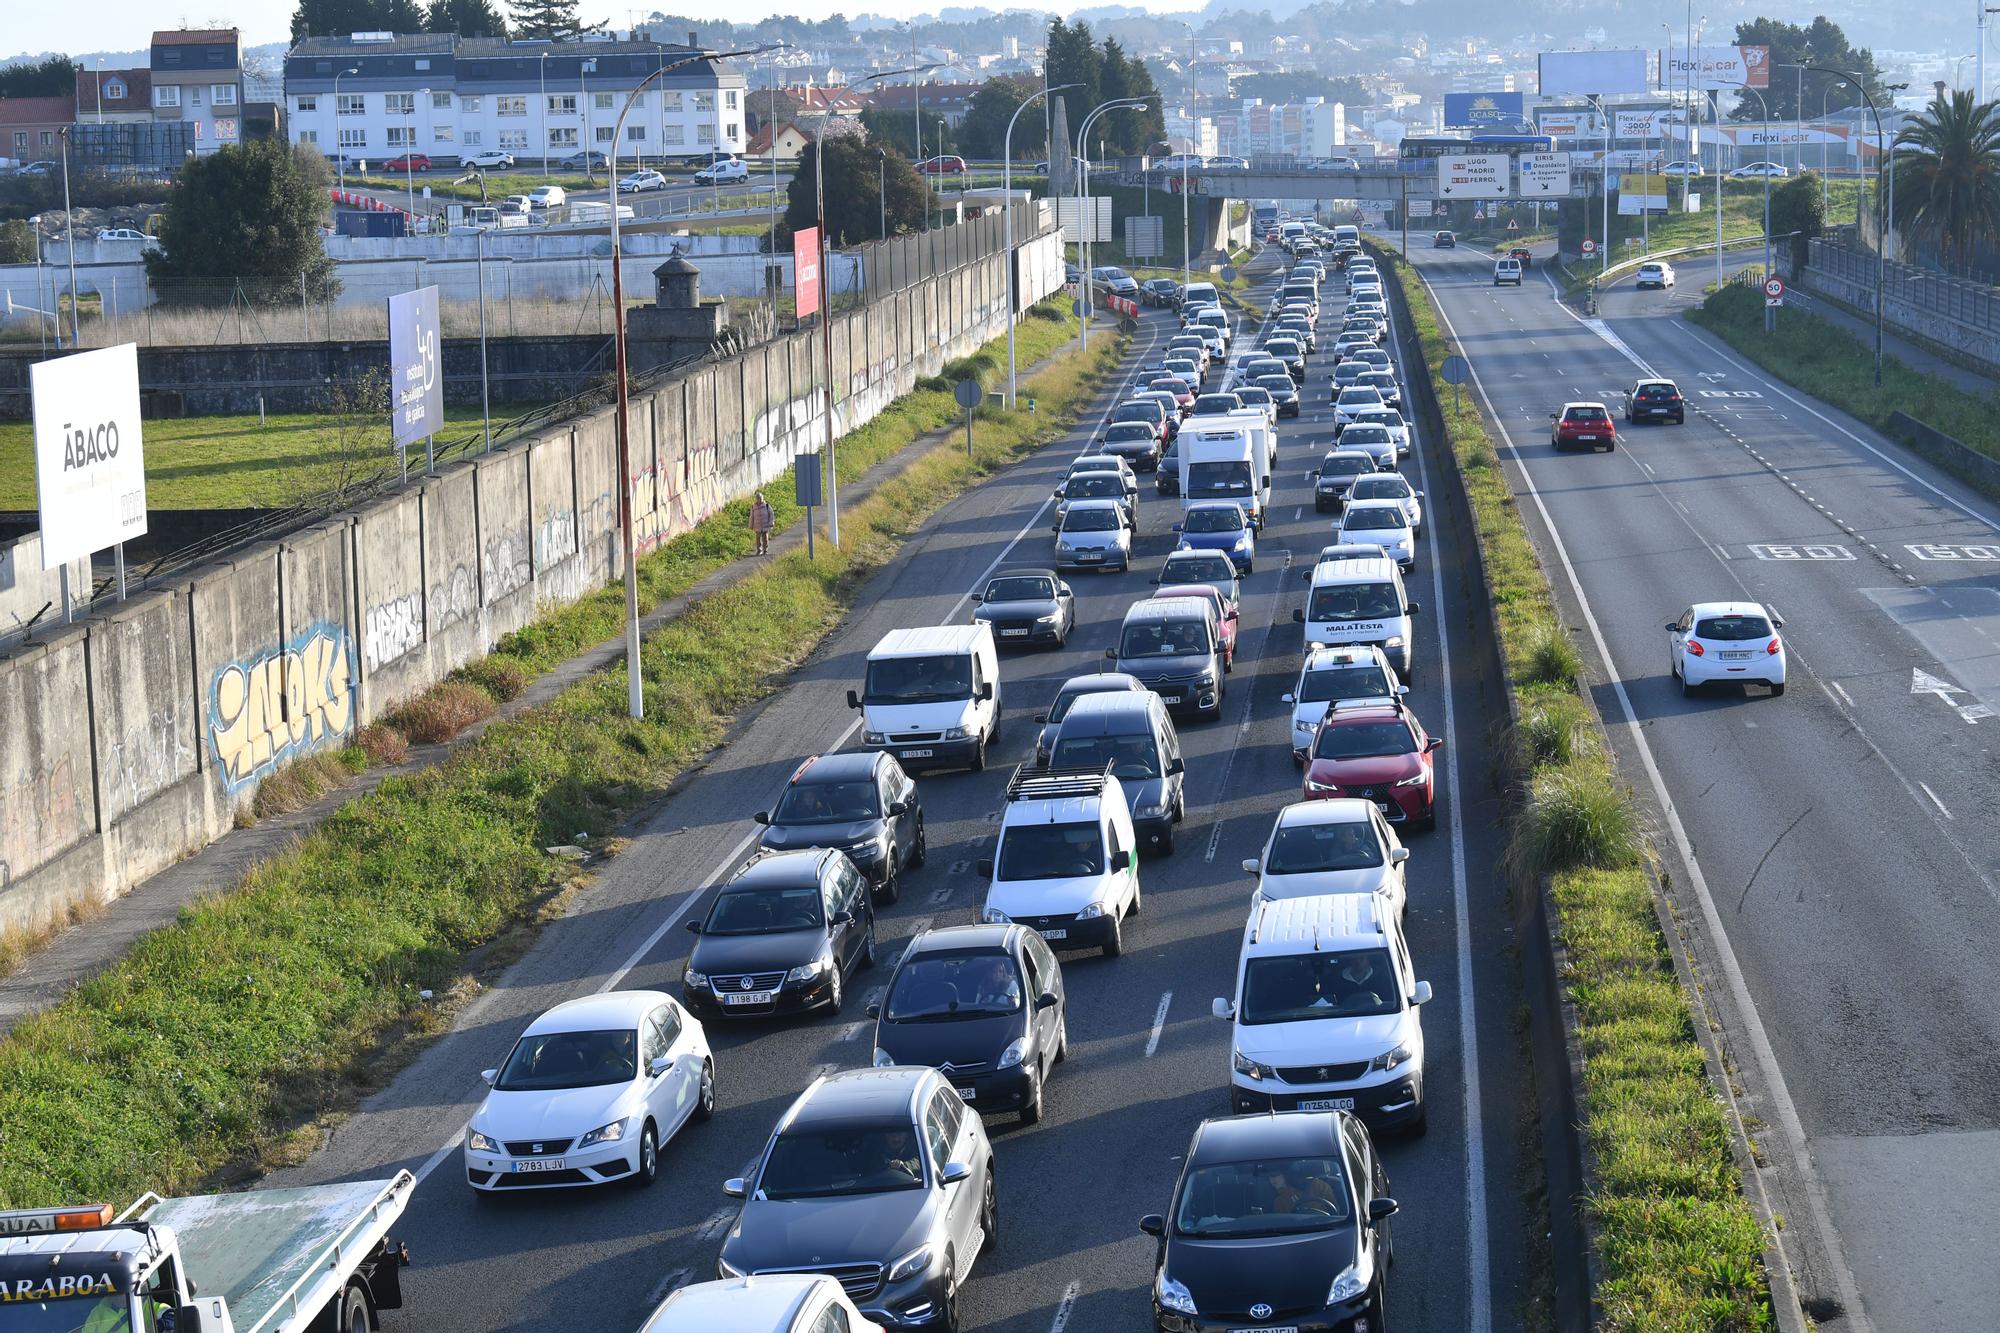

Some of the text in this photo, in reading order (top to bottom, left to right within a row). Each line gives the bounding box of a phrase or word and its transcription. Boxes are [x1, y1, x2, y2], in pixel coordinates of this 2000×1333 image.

[1469, 111, 1500, 119] OCASO
[753, 995, 768, 1003] GJF
[518, 1159, 563, 1172] 2783 LJV
